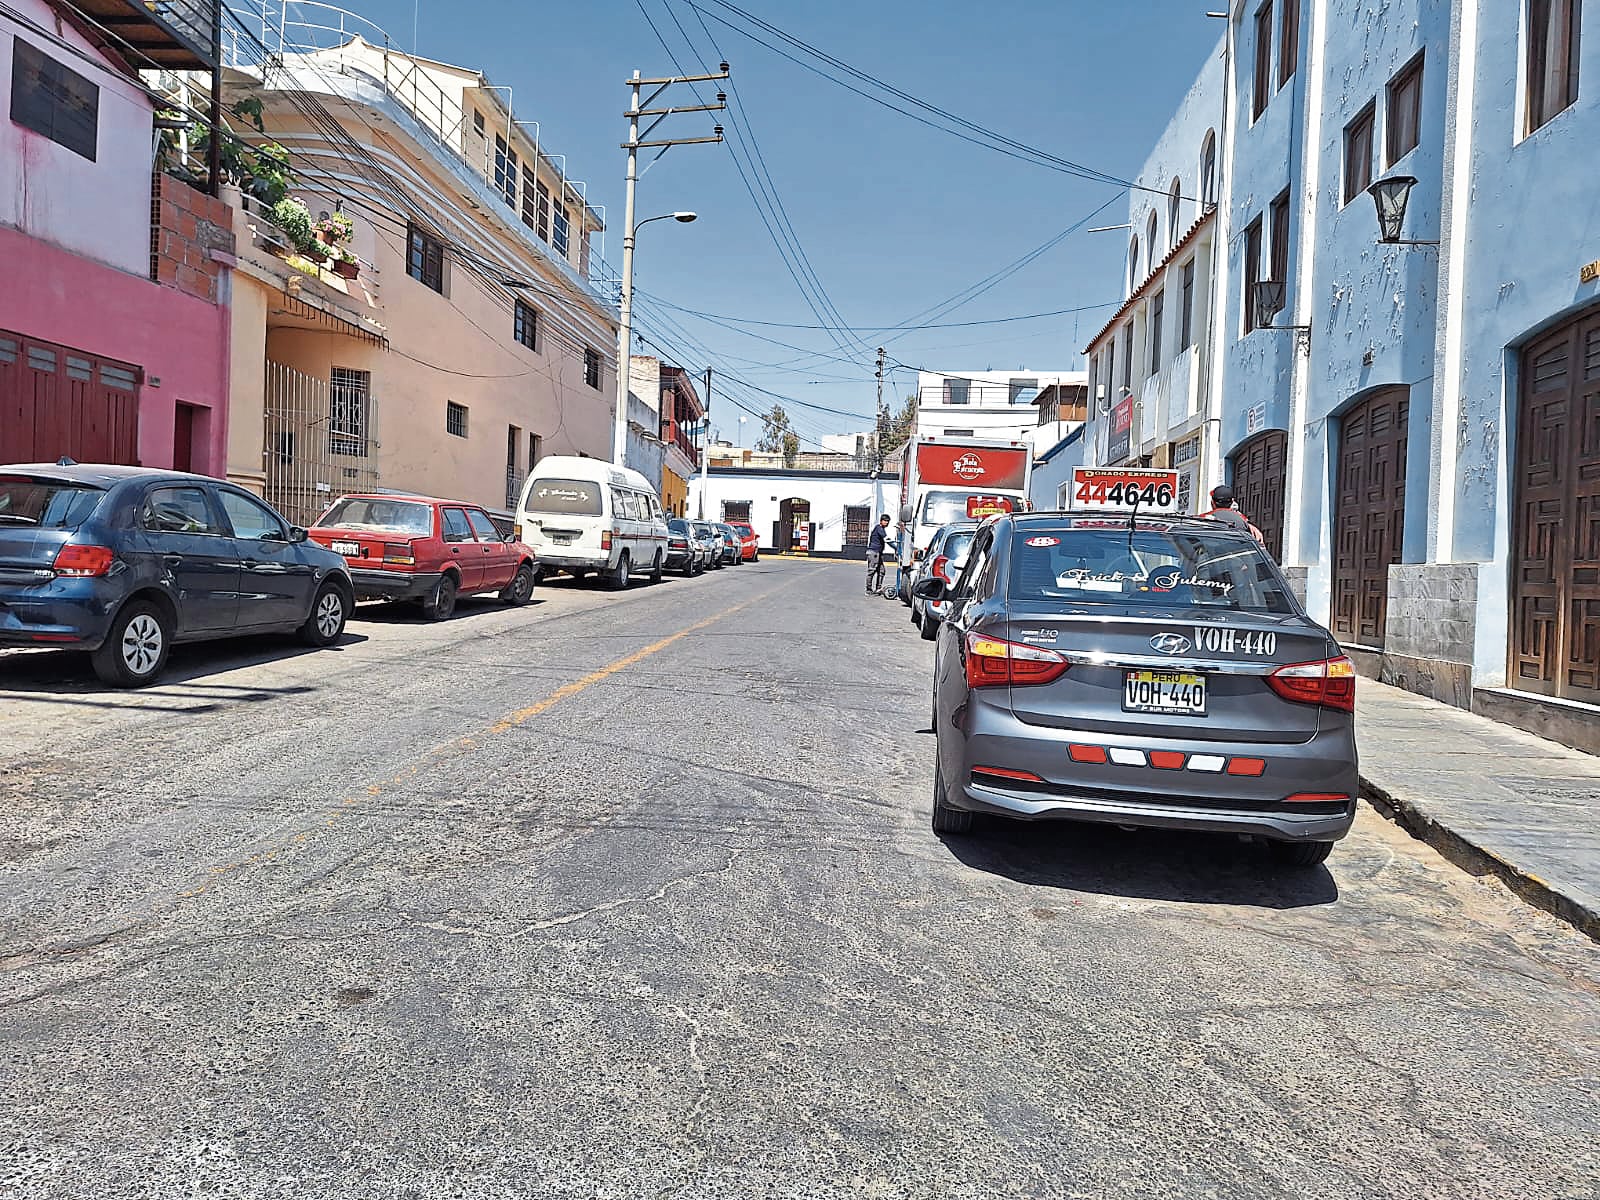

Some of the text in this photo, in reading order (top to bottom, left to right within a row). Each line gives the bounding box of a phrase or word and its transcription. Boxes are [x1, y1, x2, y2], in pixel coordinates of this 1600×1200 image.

[1127, 471, 1168, 479] EXPRESS
[1075, 480, 1172, 507] 444646
[1194, 626, 1277, 656] VOH-440
[1127, 680, 1204, 707] VOH-440
